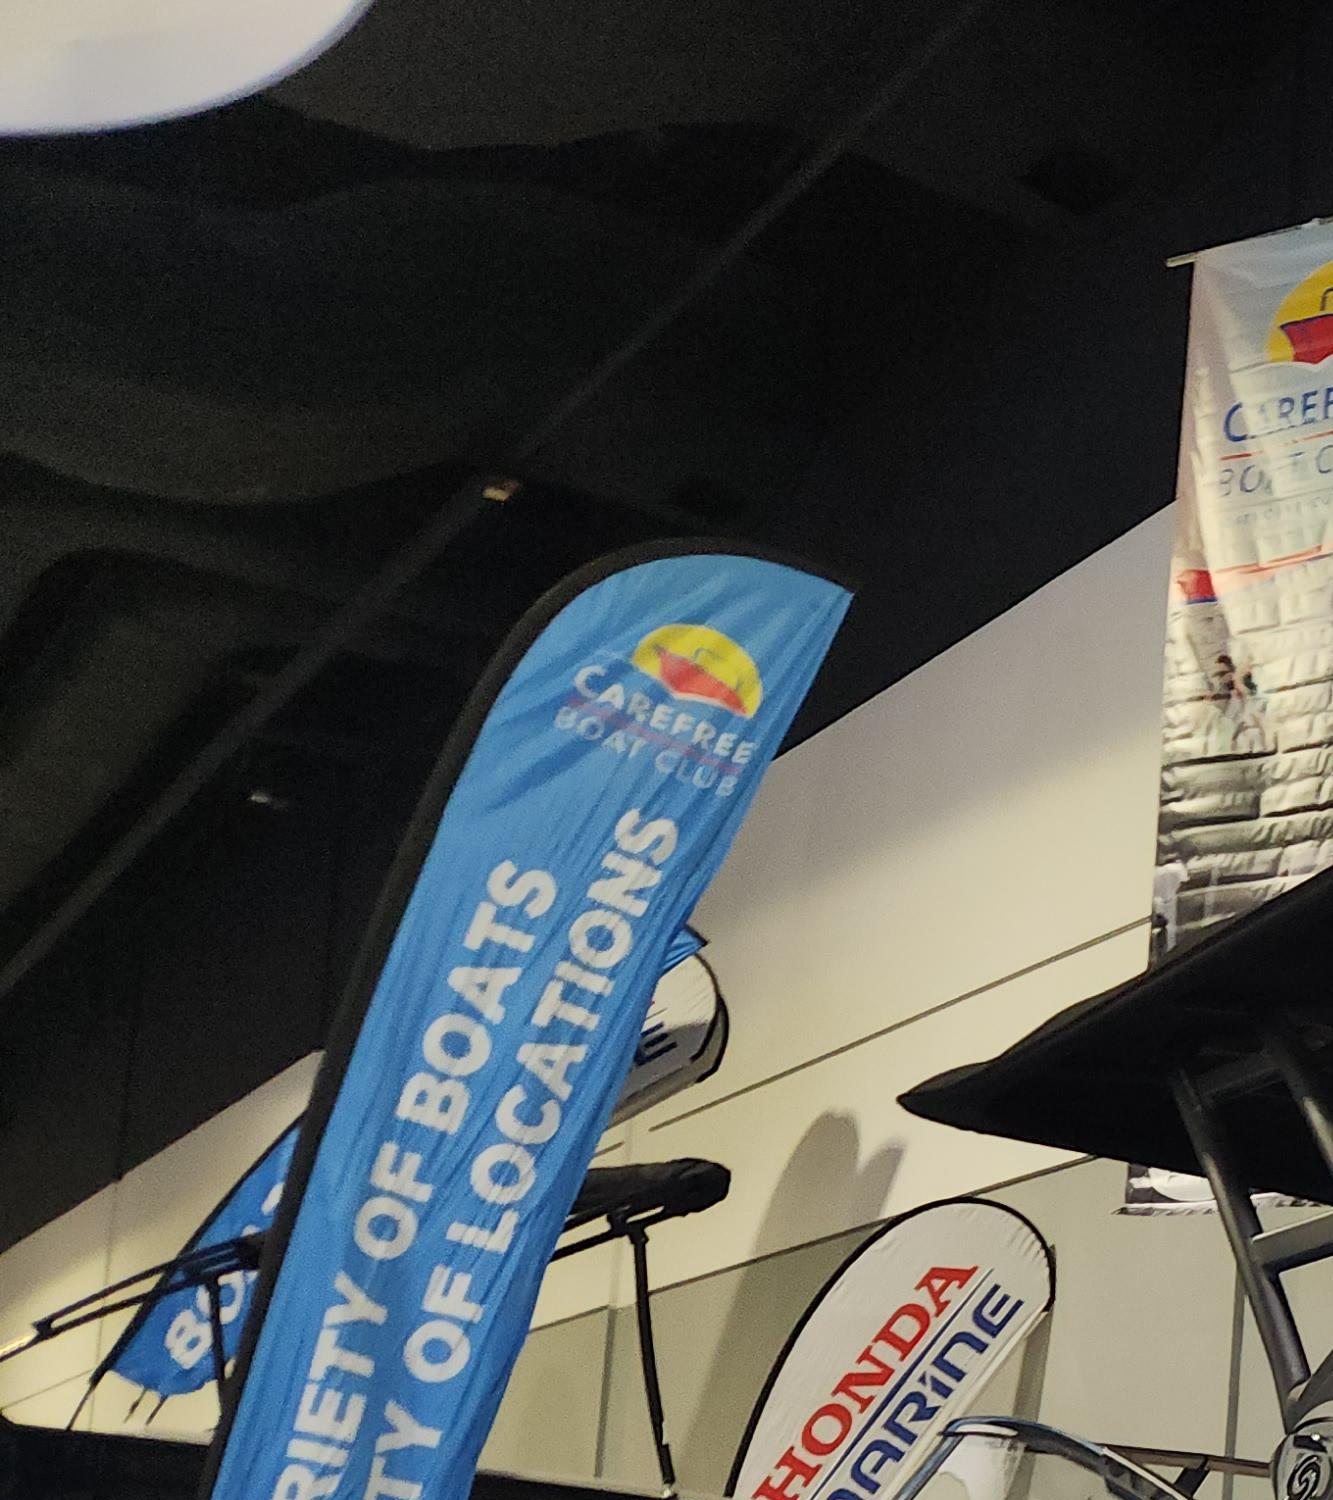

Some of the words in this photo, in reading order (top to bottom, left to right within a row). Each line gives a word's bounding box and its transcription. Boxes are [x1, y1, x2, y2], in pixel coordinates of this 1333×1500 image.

[554, 707, 648, 759] BOAT
[655, 750, 738, 797] CLUB
[574, 665, 756, 764] CAREFREE
[354, 1140, 434, 1261] OF
[395, 860, 557, 1136] BOATS
[403, 1264, 486, 1383] OF
[445, 808, 679, 1254] LOCATIONS
